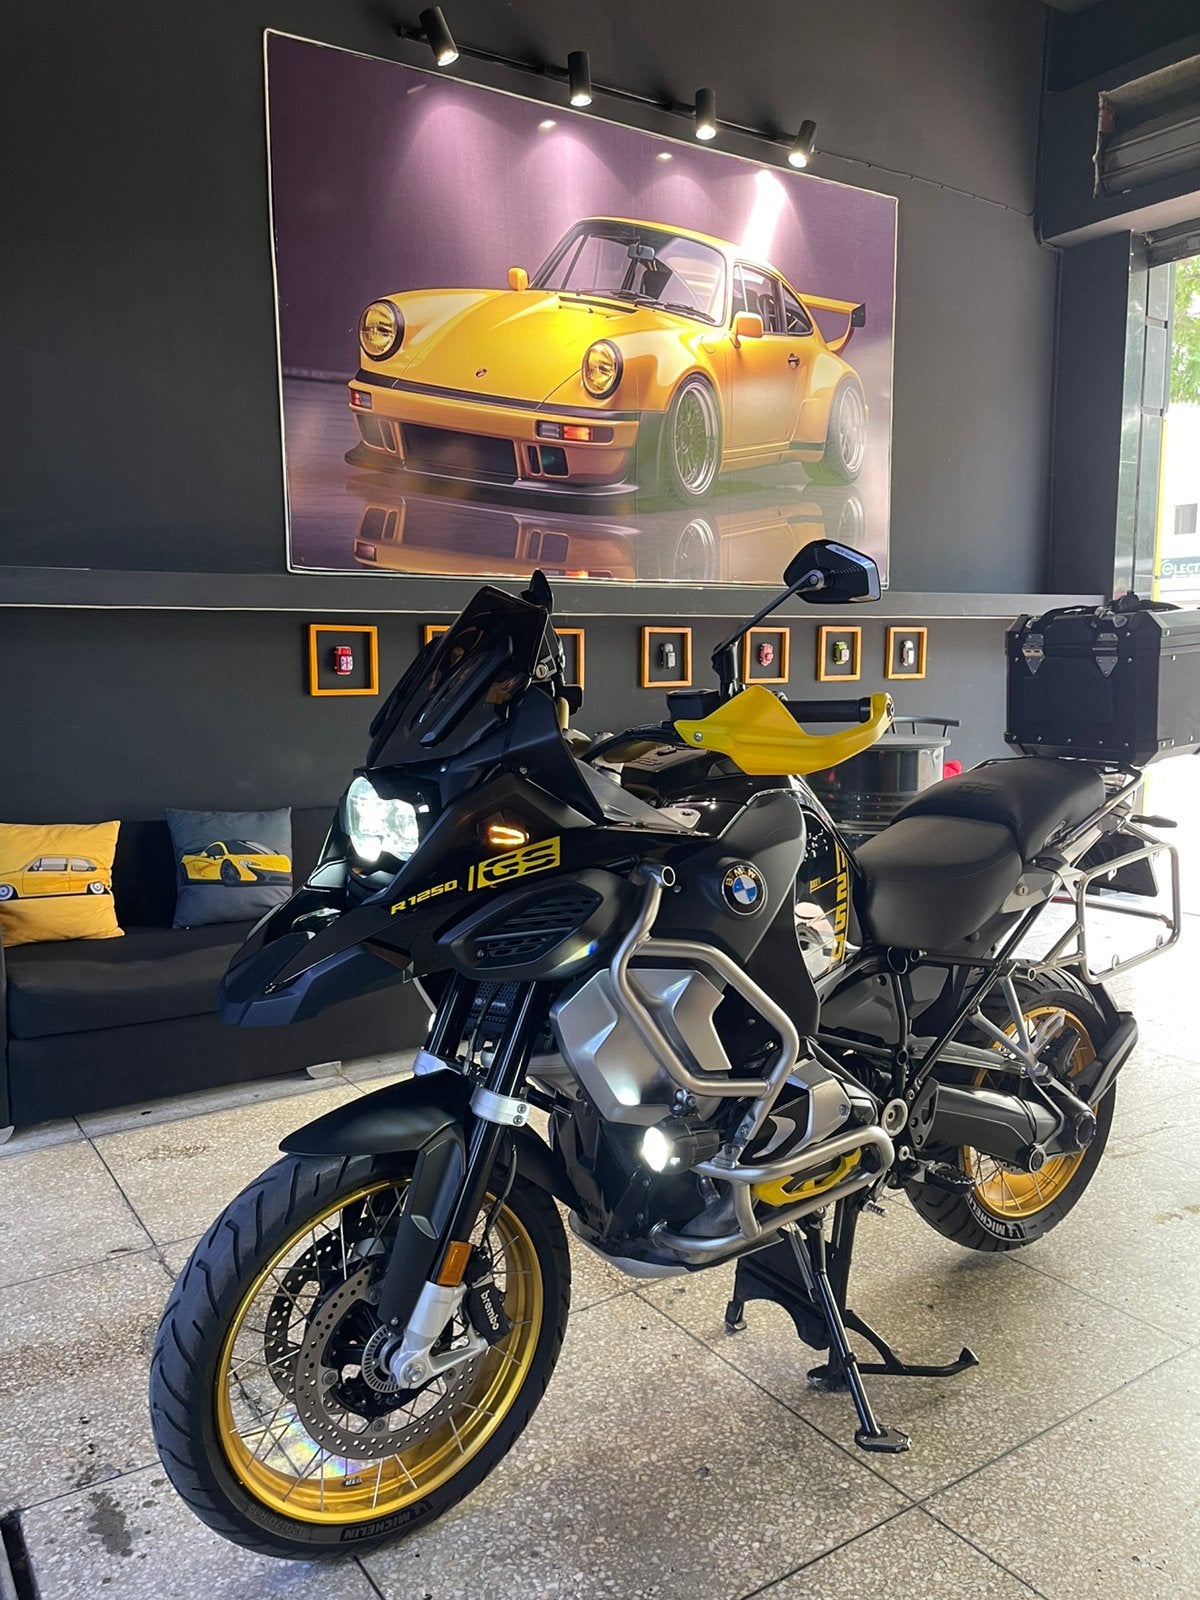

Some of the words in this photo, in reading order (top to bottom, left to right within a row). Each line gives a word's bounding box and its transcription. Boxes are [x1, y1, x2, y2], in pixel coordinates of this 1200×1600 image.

[390, 900, 406, 915] R
[408, 879, 458, 906] 1250
[482, 843, 557, 883] GS
[725, 867, 757, 887] BMW
[480, 1289, 500, 1331] brembo
[343, 1511, 411, 1540] MICHELIN
